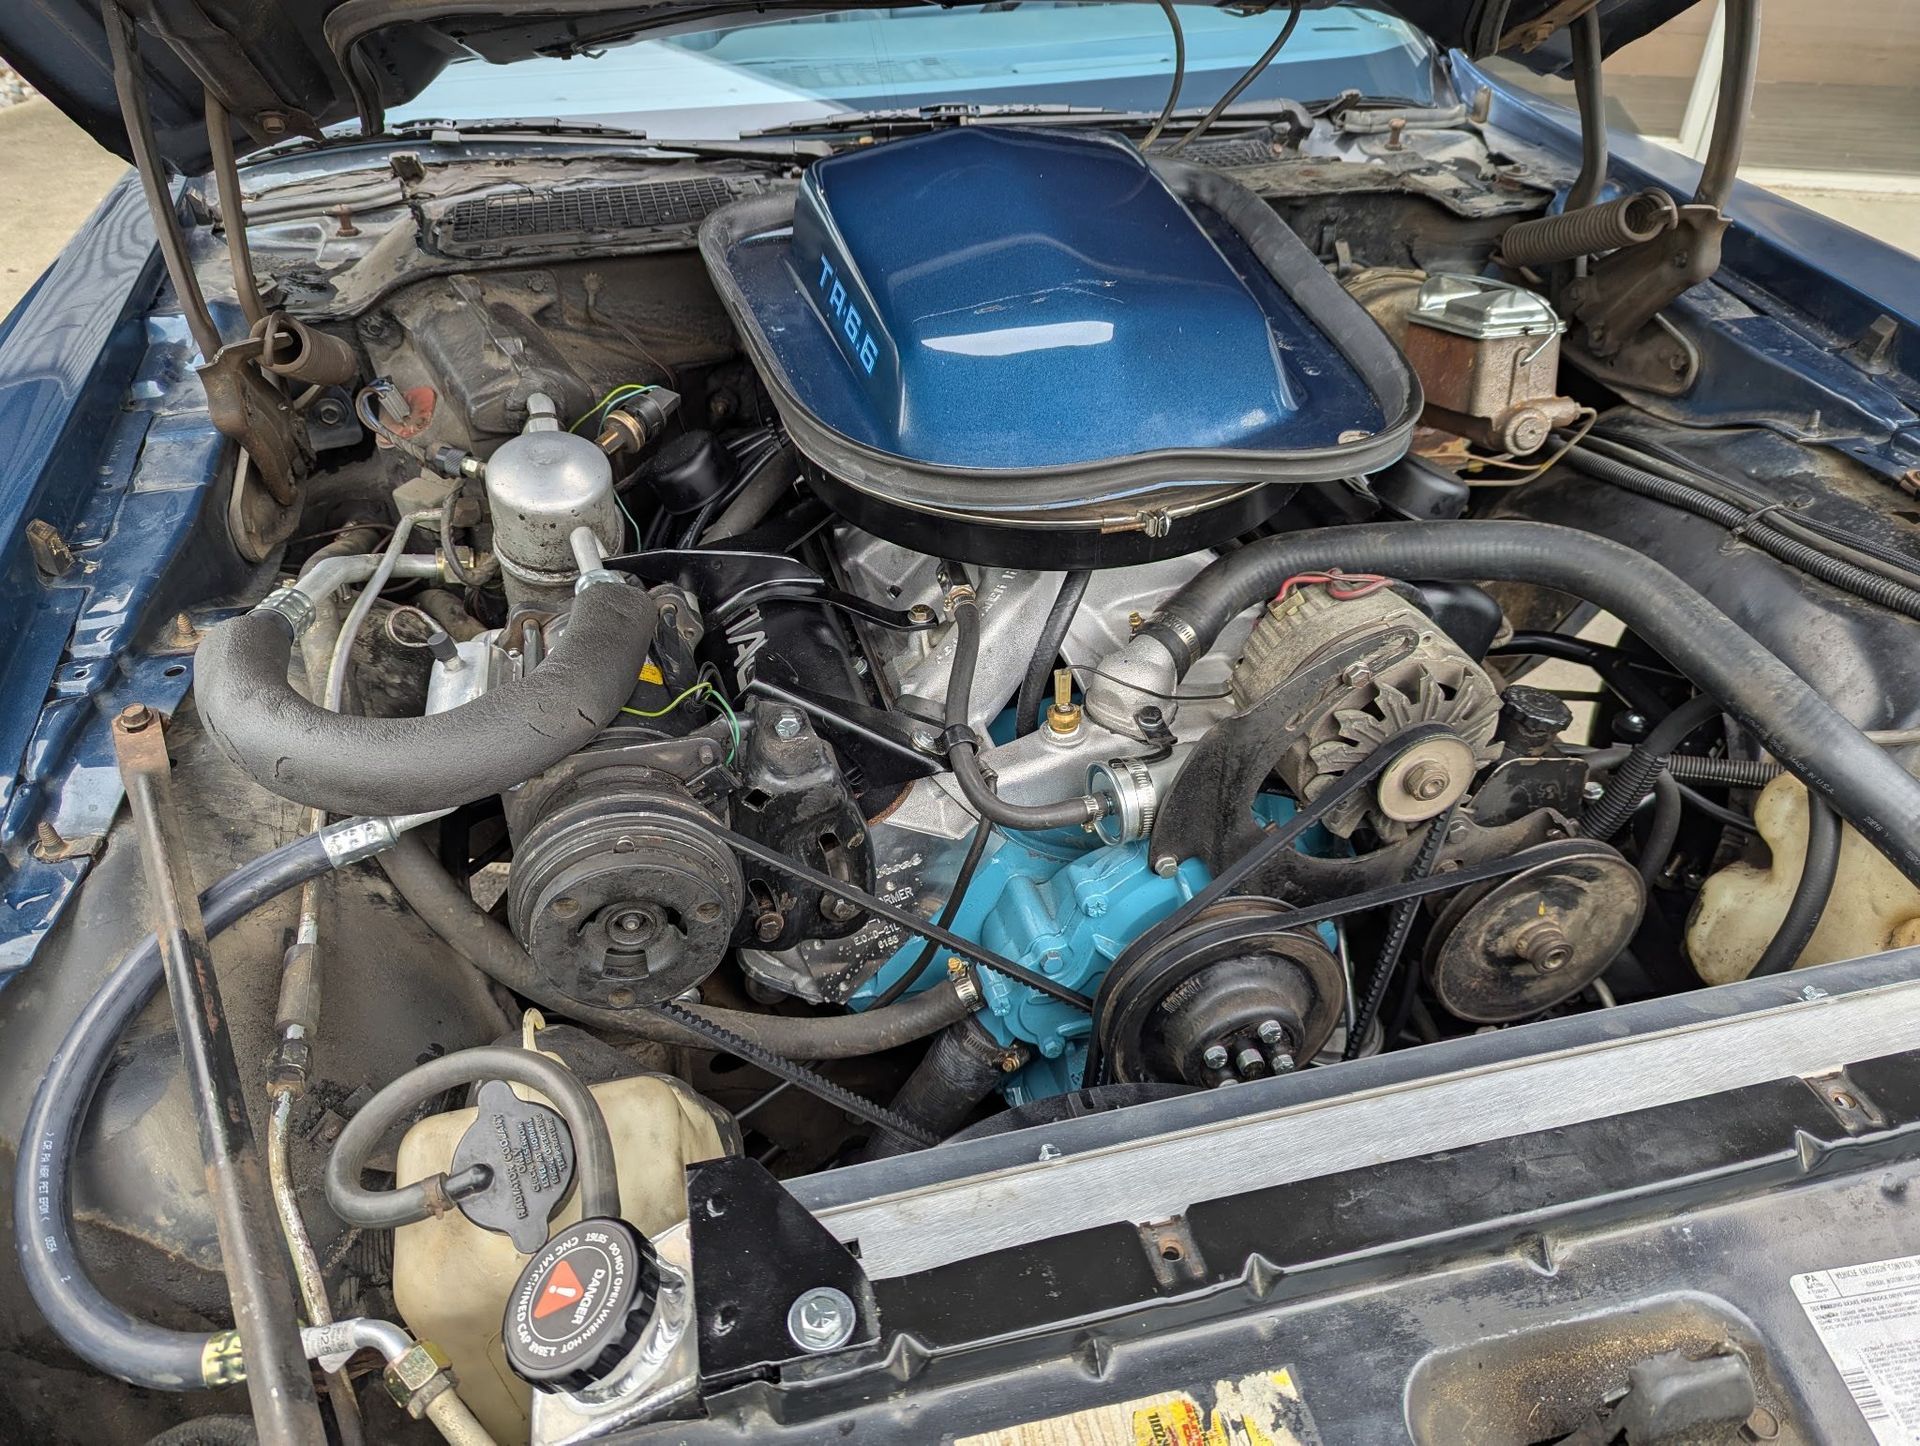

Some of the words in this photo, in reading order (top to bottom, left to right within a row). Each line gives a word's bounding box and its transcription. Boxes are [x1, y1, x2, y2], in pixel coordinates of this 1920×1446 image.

[493, 1113, 514, 1162] COOLANT
[518, 1120, 534, 1165] RESERVOIR
[527, 1116, 541, 1151] NORMAL
[535, 1112, 552, 1156] OPERATING
[546, 1117, 568, 1172] TEMPERATURE
[512, 1147, 528, 1174] ONLY
[534, 1151, 545, 1163] AT
[546, 1156, 561, 1185] ENGINE
[507, 1164, 529, 1220] RADIATOR
[538, 1165, 551, 1189] LEVEL
[555, 1236, 580, 1256] CNC
[608, 1242, 621, 1257] DO
[613, 1254, 625, 1277] NOT
[516, 1255, 555, 1322] MACHINED
[571, 1268, 607, 1325] DANGER
[607, 1277, 624, 1307] OPEN
[516, 1323, 532, 1345] CAP
[582, 1308, 611, 1341] WHEN
[560, 1333, 584, 1354] HOT
